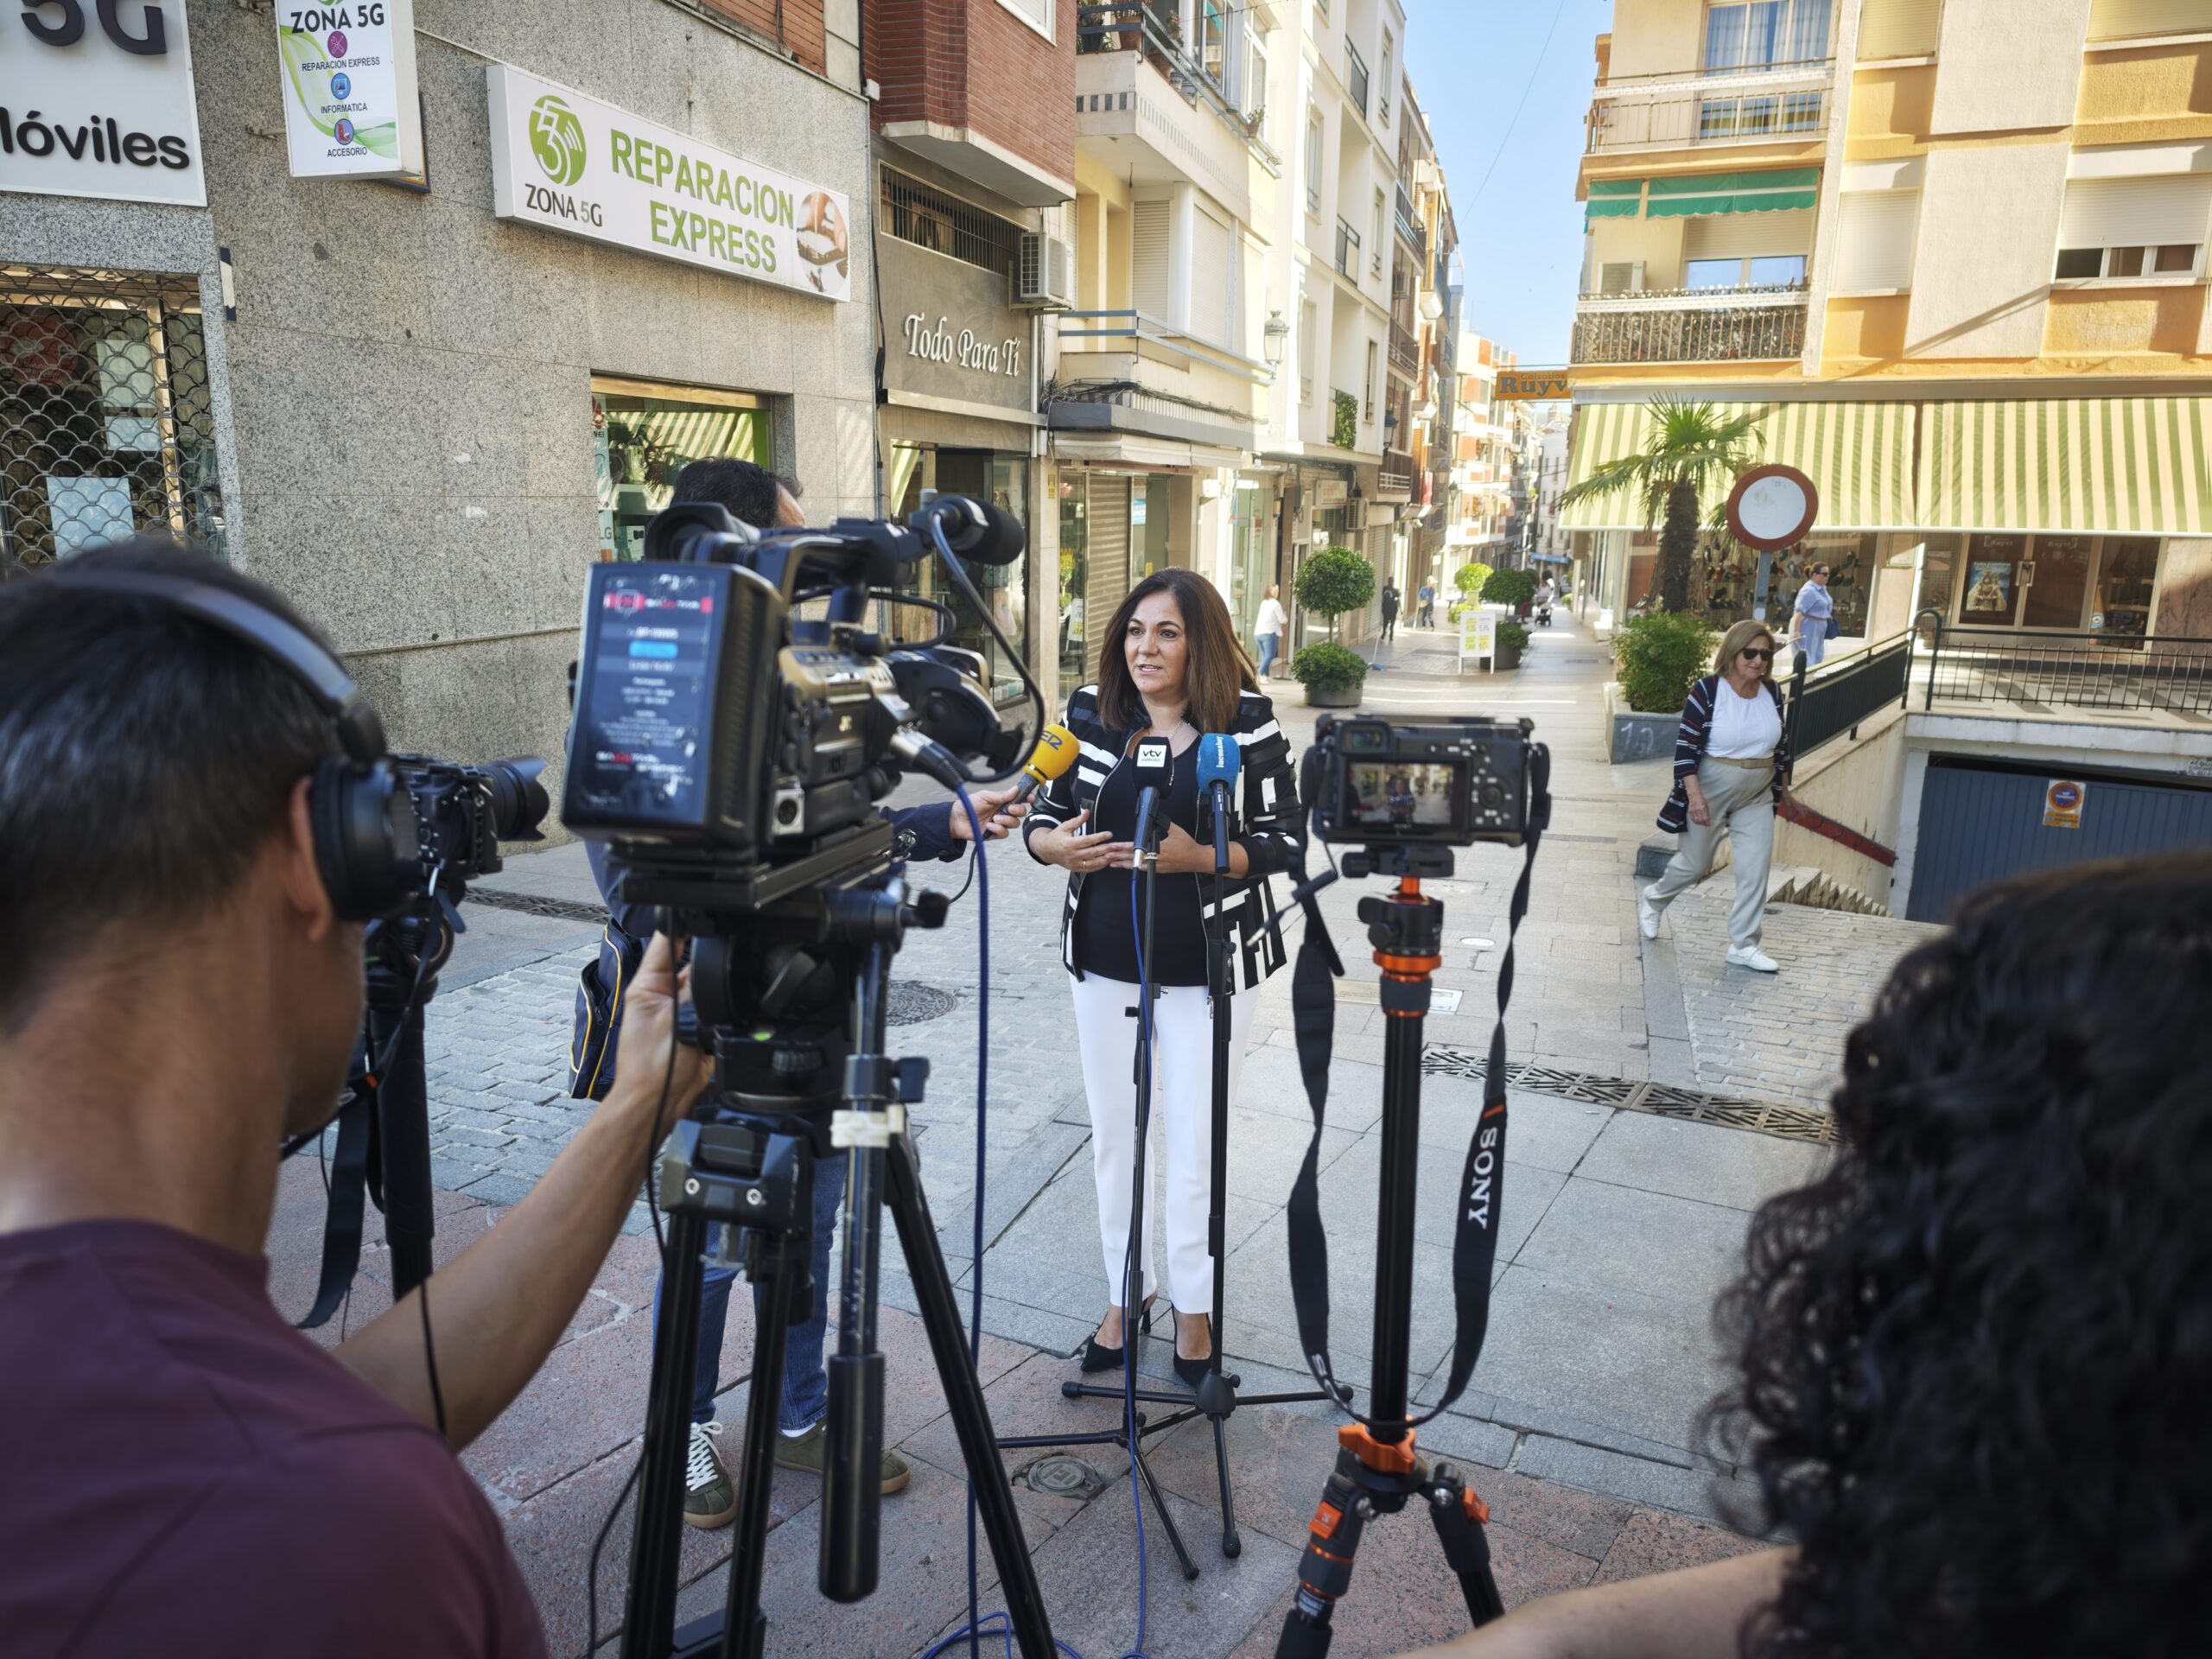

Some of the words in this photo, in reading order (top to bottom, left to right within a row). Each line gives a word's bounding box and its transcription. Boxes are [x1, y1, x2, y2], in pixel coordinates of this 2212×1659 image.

[290, 7, 352, 34] ZONA
[358, 3, 385, 28] 5G
[302, 59, 346, 72] REPARACION
[348, 56, 380, 68] EXPRESS
[321, 103, 367, 114] INFORMATICA
[327, 146, 367, 157] ACCESORIO
[611, 128, 794, 230] REPARACION
[524, 182, 578, 221] ZONA
[581, 200, 603, 227] 5G
[650, 200, 777, 273] EXPRESS
[904, 312, 954, 363] Todo
[957, 328, 999, 373] Para
[1143, 749, 1162, 758] vtv
[1468, 1127, 1497, 1230] SONY
